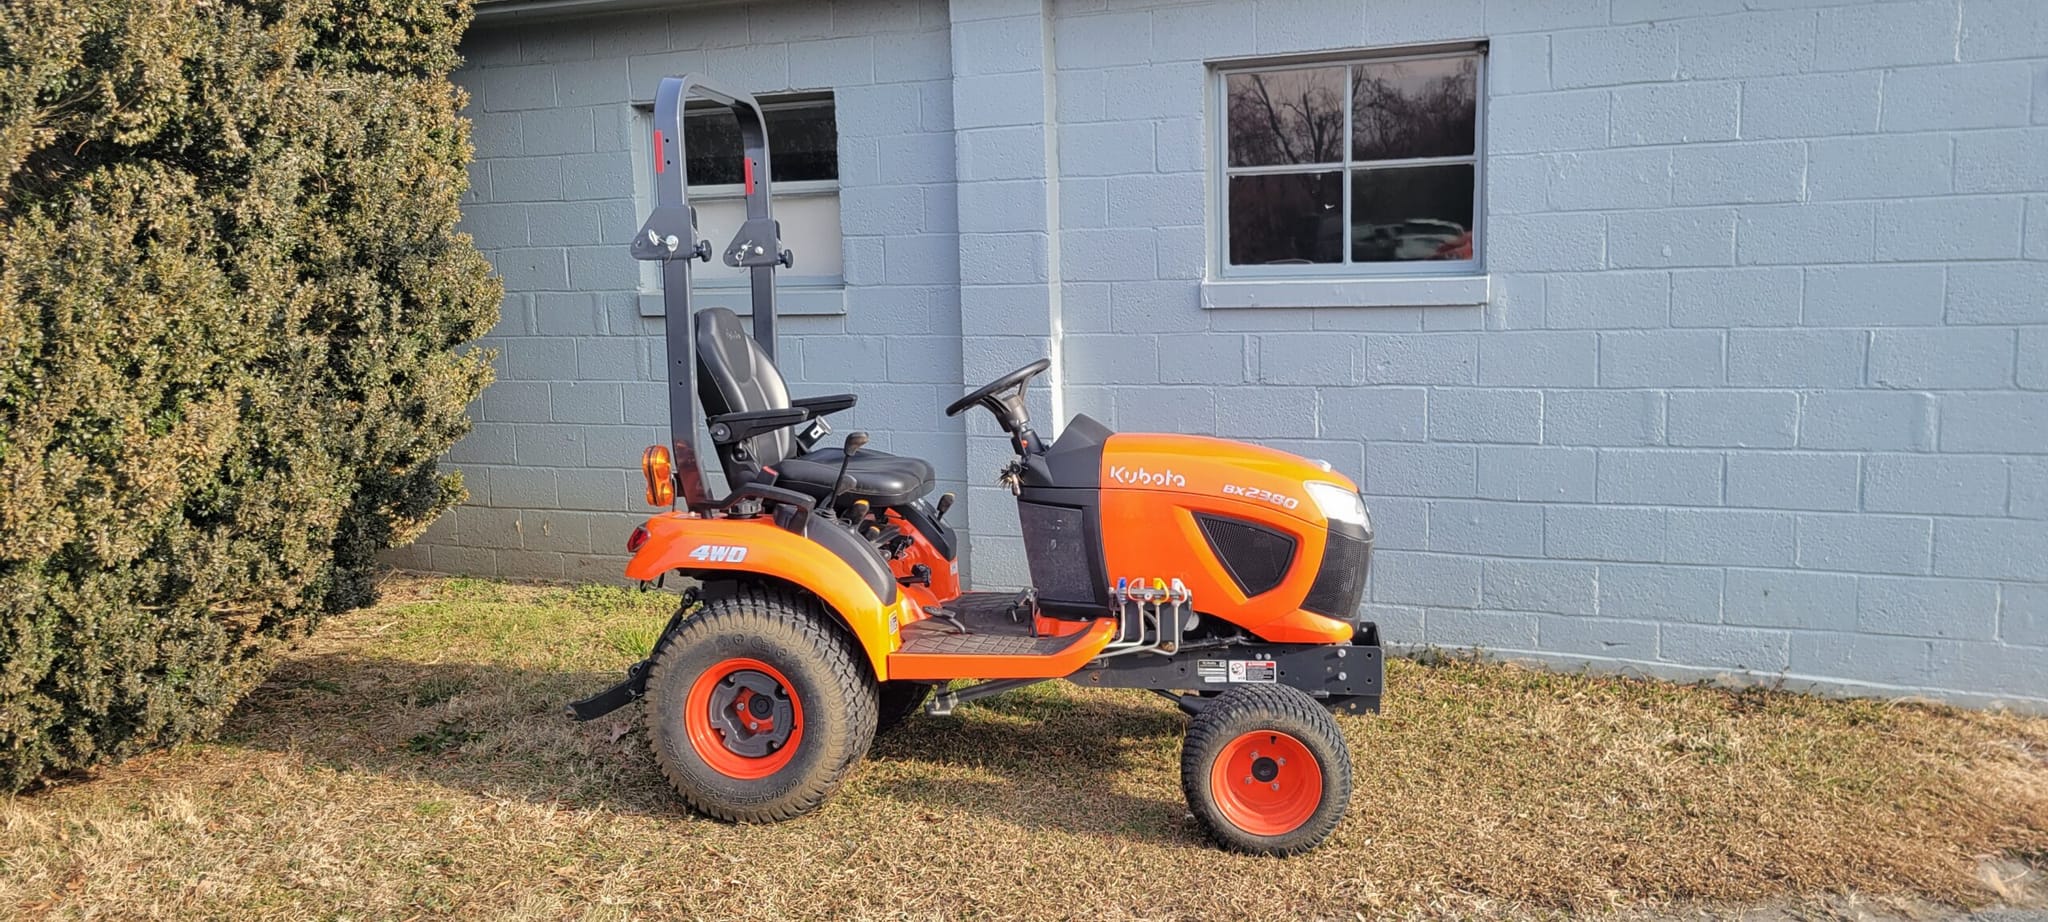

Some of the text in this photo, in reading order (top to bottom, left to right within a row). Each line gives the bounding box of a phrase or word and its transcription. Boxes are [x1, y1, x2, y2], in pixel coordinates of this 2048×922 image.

[1110, 465, 1186, 488] Kubota
[1222, 484, 1300, 510] BX2380
[688, 544, 749, 563] 4WD
